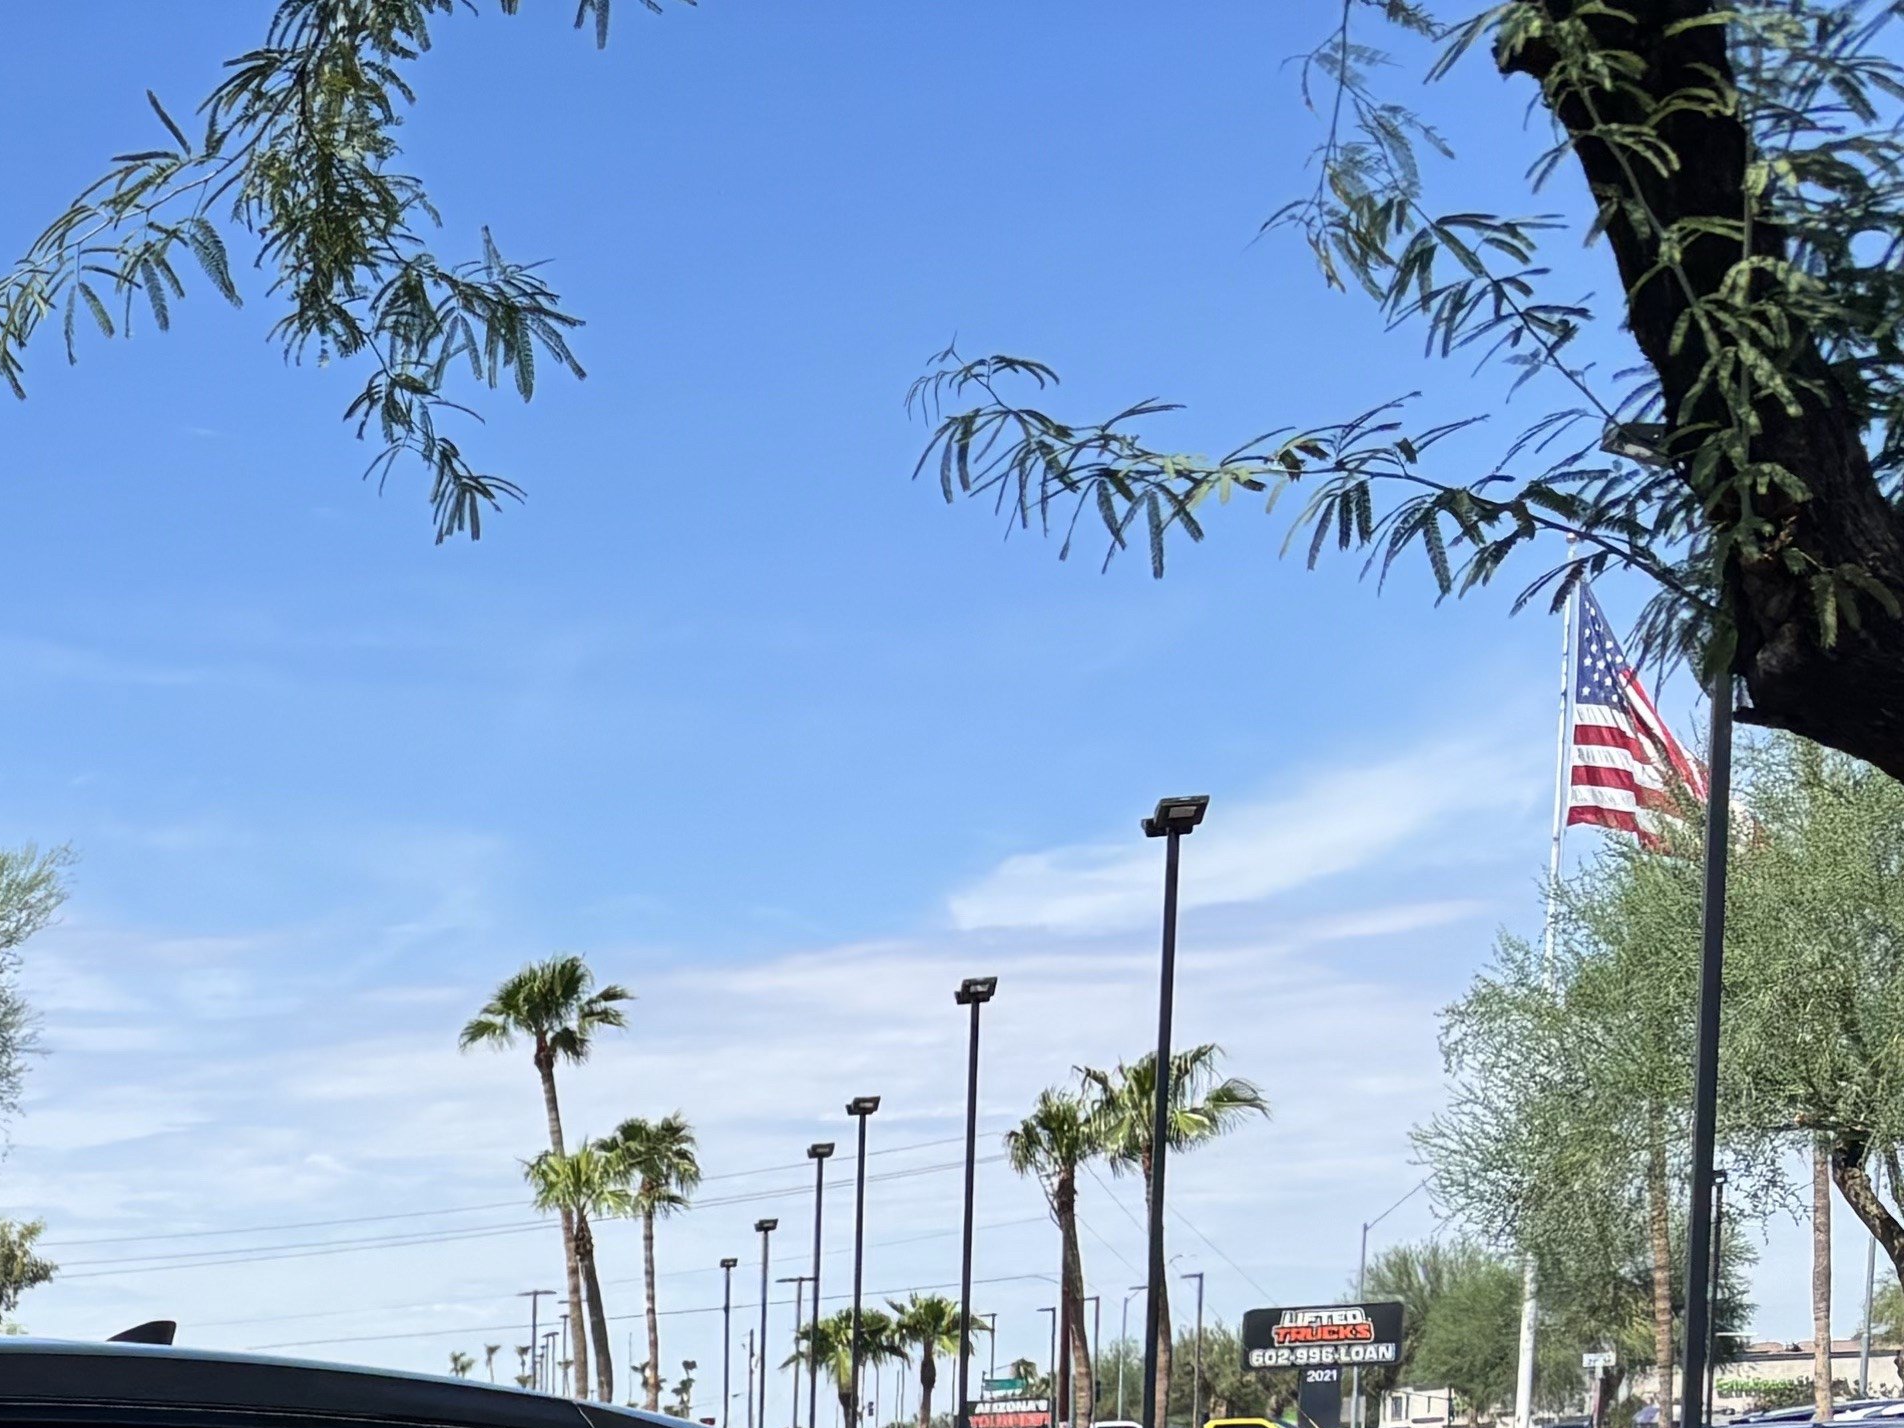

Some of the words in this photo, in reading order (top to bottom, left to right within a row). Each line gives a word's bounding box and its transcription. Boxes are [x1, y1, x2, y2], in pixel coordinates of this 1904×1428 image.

[1282, 1309, 1364, 1326] LIFTED
[1274, 1323, 1372, 1345] TRUCKS
[1306, 1369, 1337, 1382] 2021
